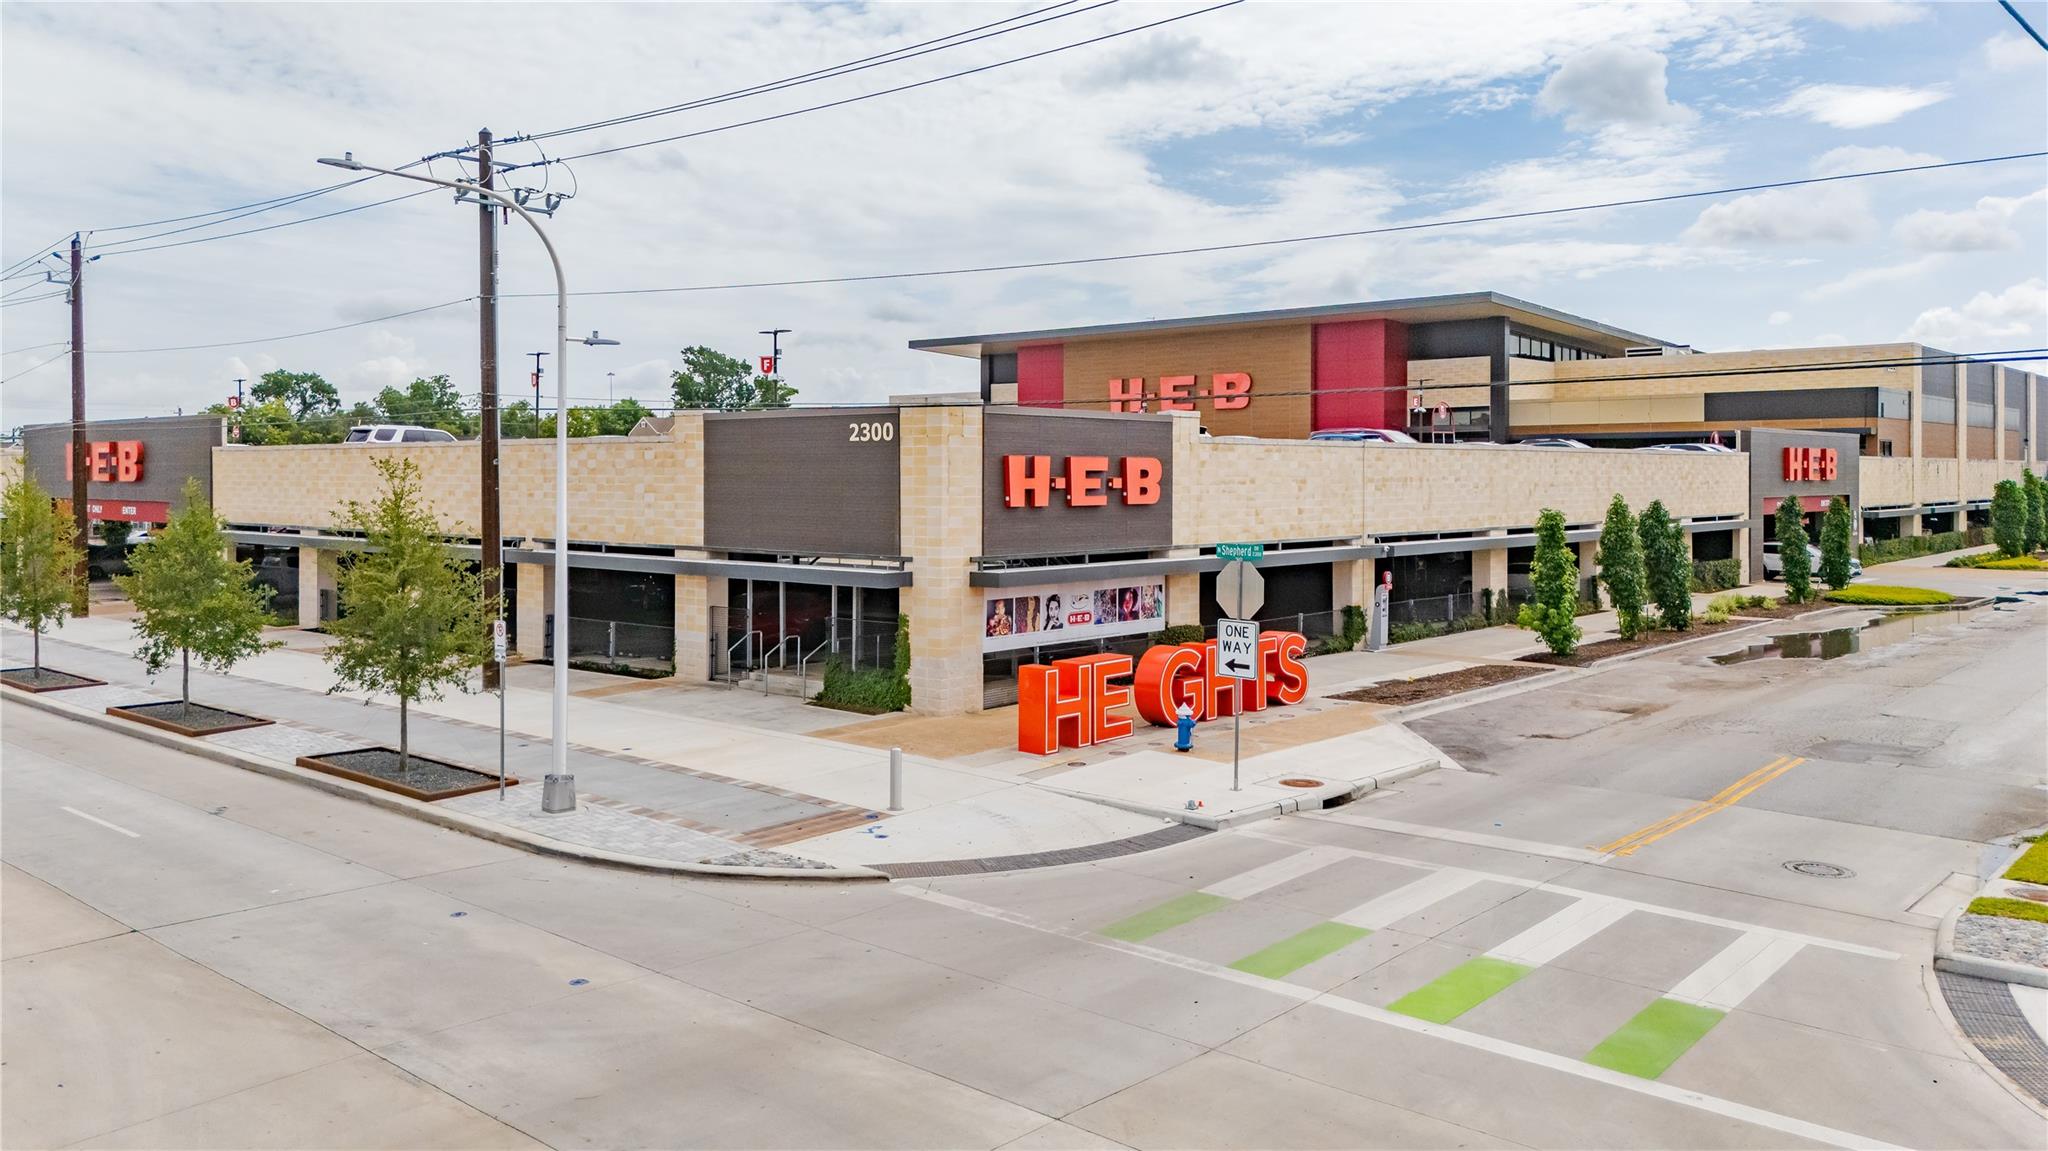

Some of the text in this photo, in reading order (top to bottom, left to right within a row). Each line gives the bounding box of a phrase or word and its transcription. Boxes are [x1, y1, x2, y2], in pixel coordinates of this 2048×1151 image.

[849, 422, 894, 442] 2300
[1783, 447, 1838, 482] H-E-B
[1002, 454, 1163, 508] H-E-B
[1221, 545, 1252, 557] Shepherd
[1225, 624, 1250, 639] ONE
[1222, 641, 1252, 655] WAY
